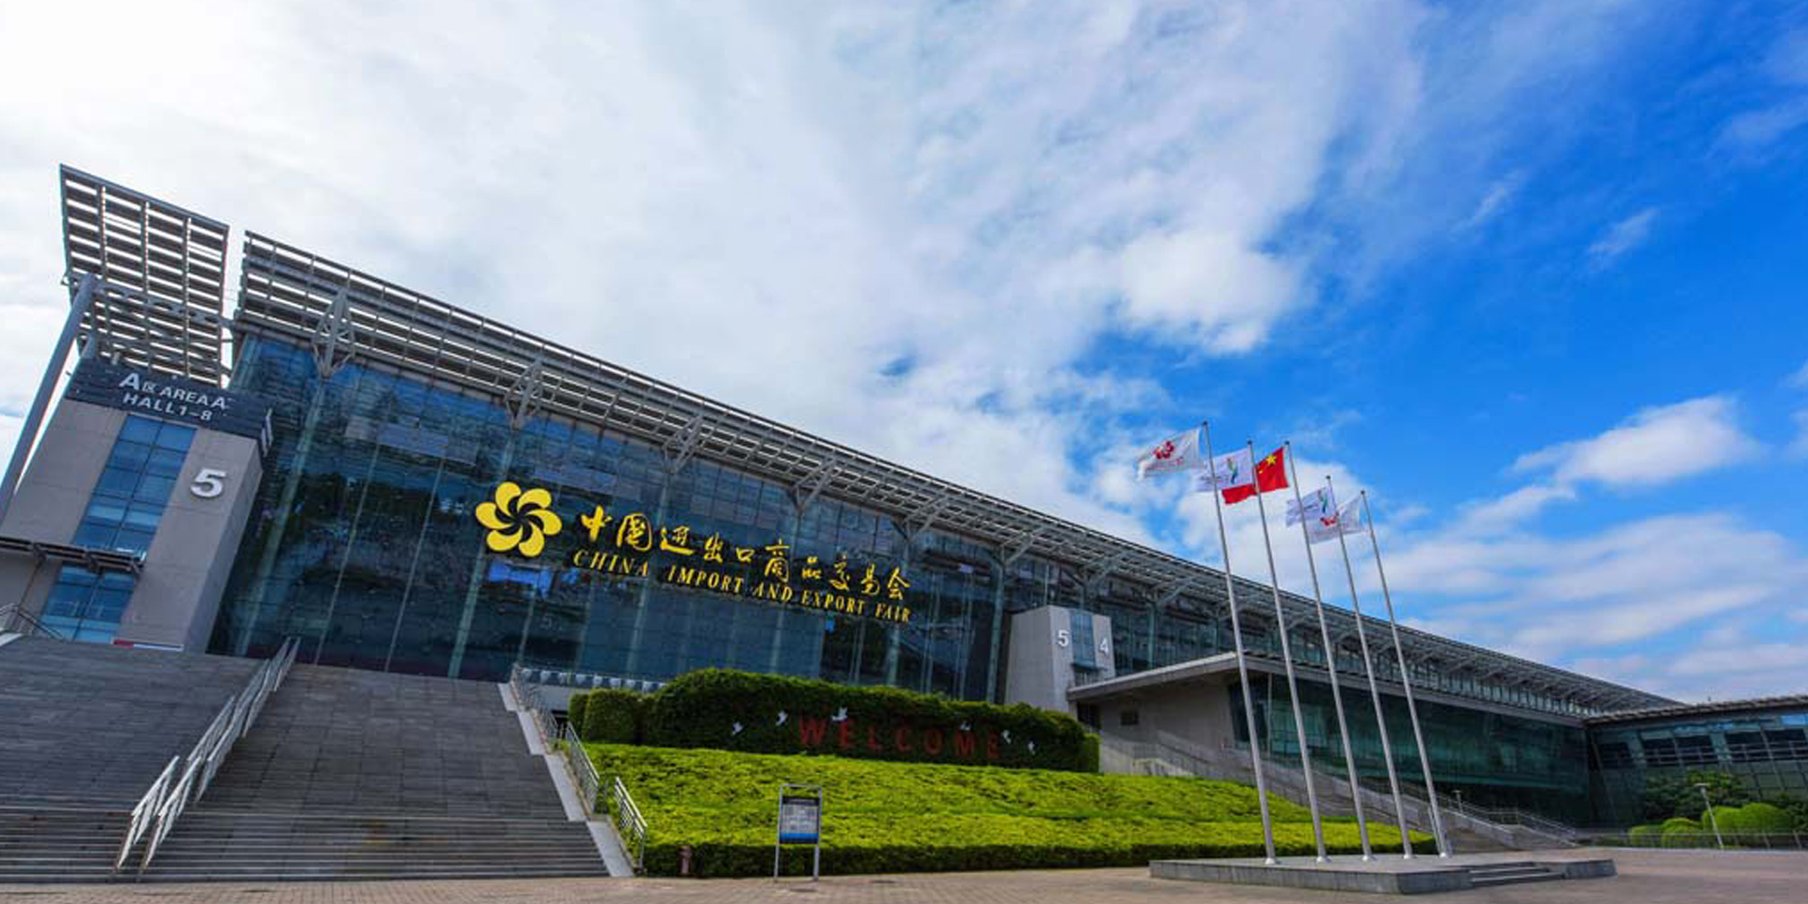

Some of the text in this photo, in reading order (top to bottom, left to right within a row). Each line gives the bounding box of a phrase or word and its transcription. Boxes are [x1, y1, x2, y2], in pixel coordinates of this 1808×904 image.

[190, 469, 226, 498] 5
[572, 549, 911, 624] CHINA IMPORT AND EXPORT FAIR
[1058, 629, 1070, 648] 5
[1099, 637, 1110, 656] 4
[797, 717, 1001, 760] WELCOME
